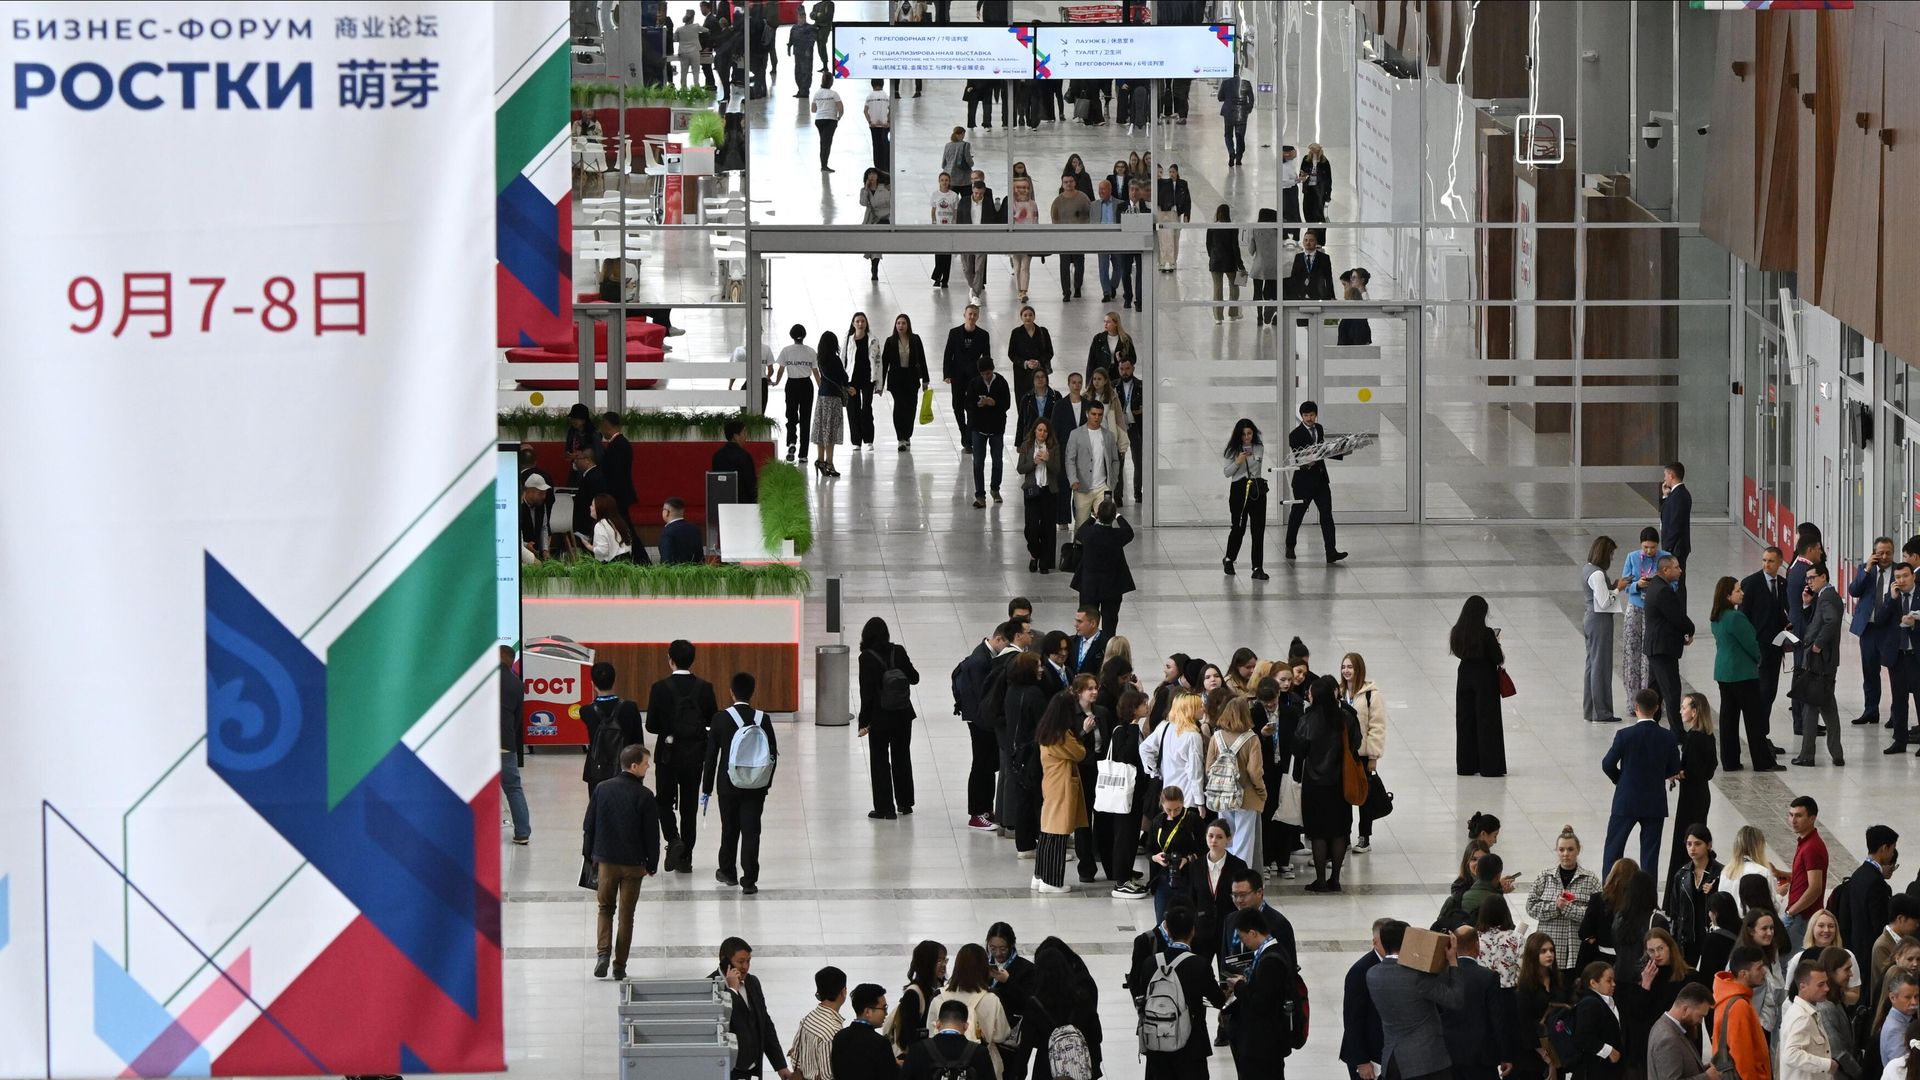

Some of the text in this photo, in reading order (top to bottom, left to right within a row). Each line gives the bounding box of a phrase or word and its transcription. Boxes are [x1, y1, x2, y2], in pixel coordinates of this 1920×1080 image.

[13, 15, 439, 40] БИЗНЕС-ФОРУМ 商业论坛
[14, 58, 439, 110] РОСТКИ 萌芽
[67, 271, 367, 339] 9月7-8日
[524, 677, 576, 695] ГОСТ
